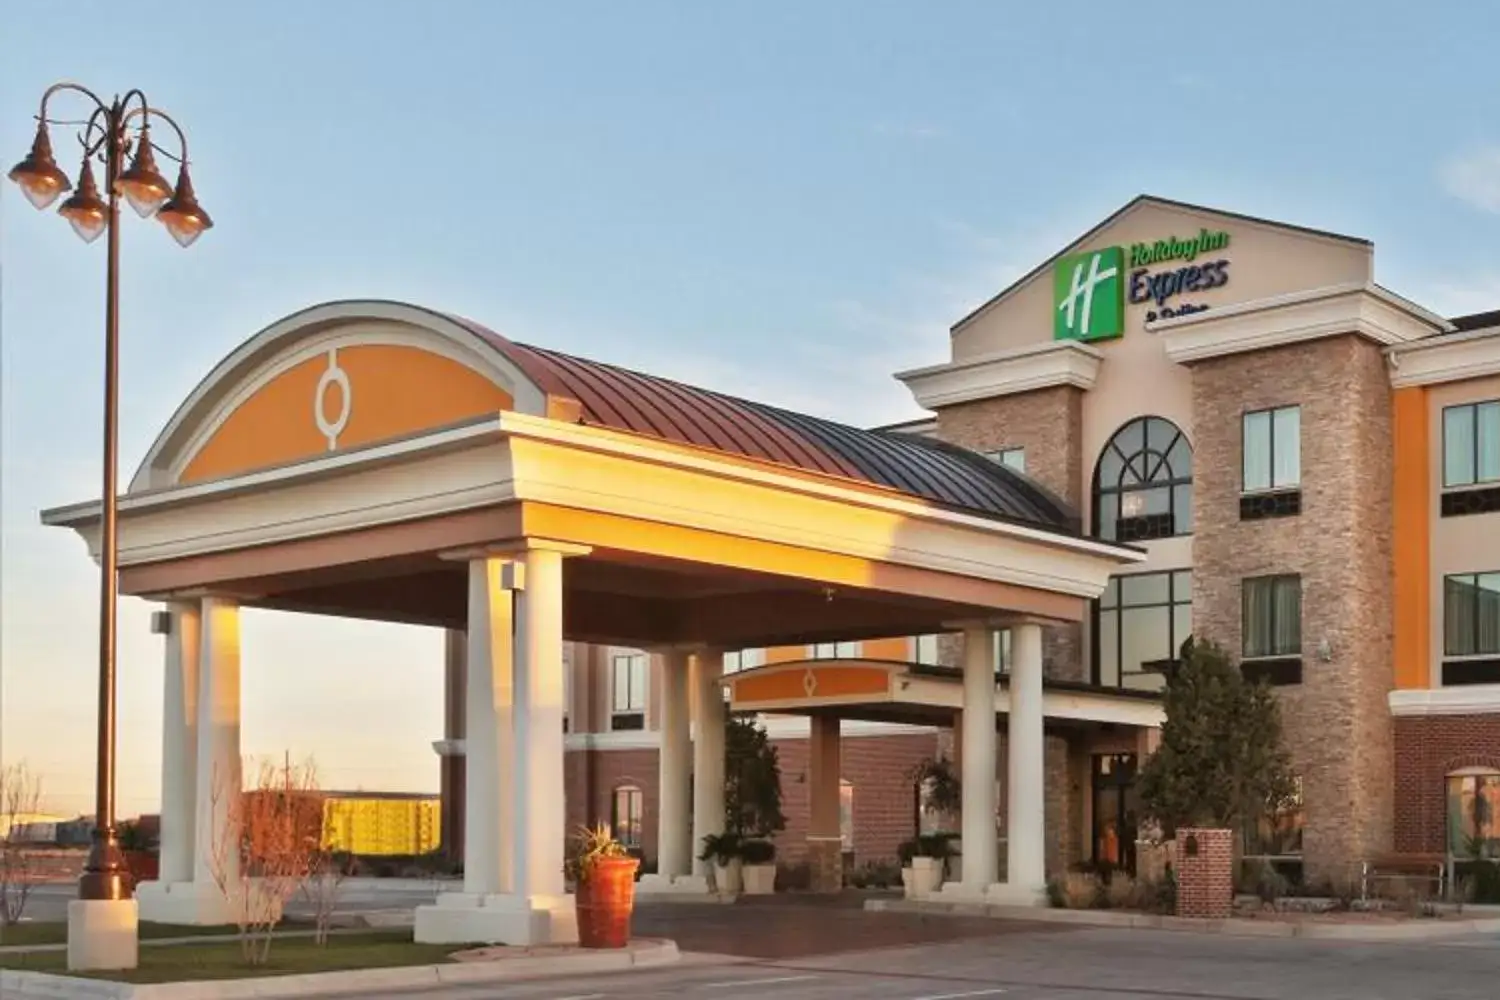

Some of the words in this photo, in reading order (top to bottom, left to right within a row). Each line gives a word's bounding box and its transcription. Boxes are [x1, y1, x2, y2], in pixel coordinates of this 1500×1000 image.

[1130, 236, 1199, 268] Holiday
[1199, 228, 1230, 251] Inn
[1129, 259, 1231, 306] Express
